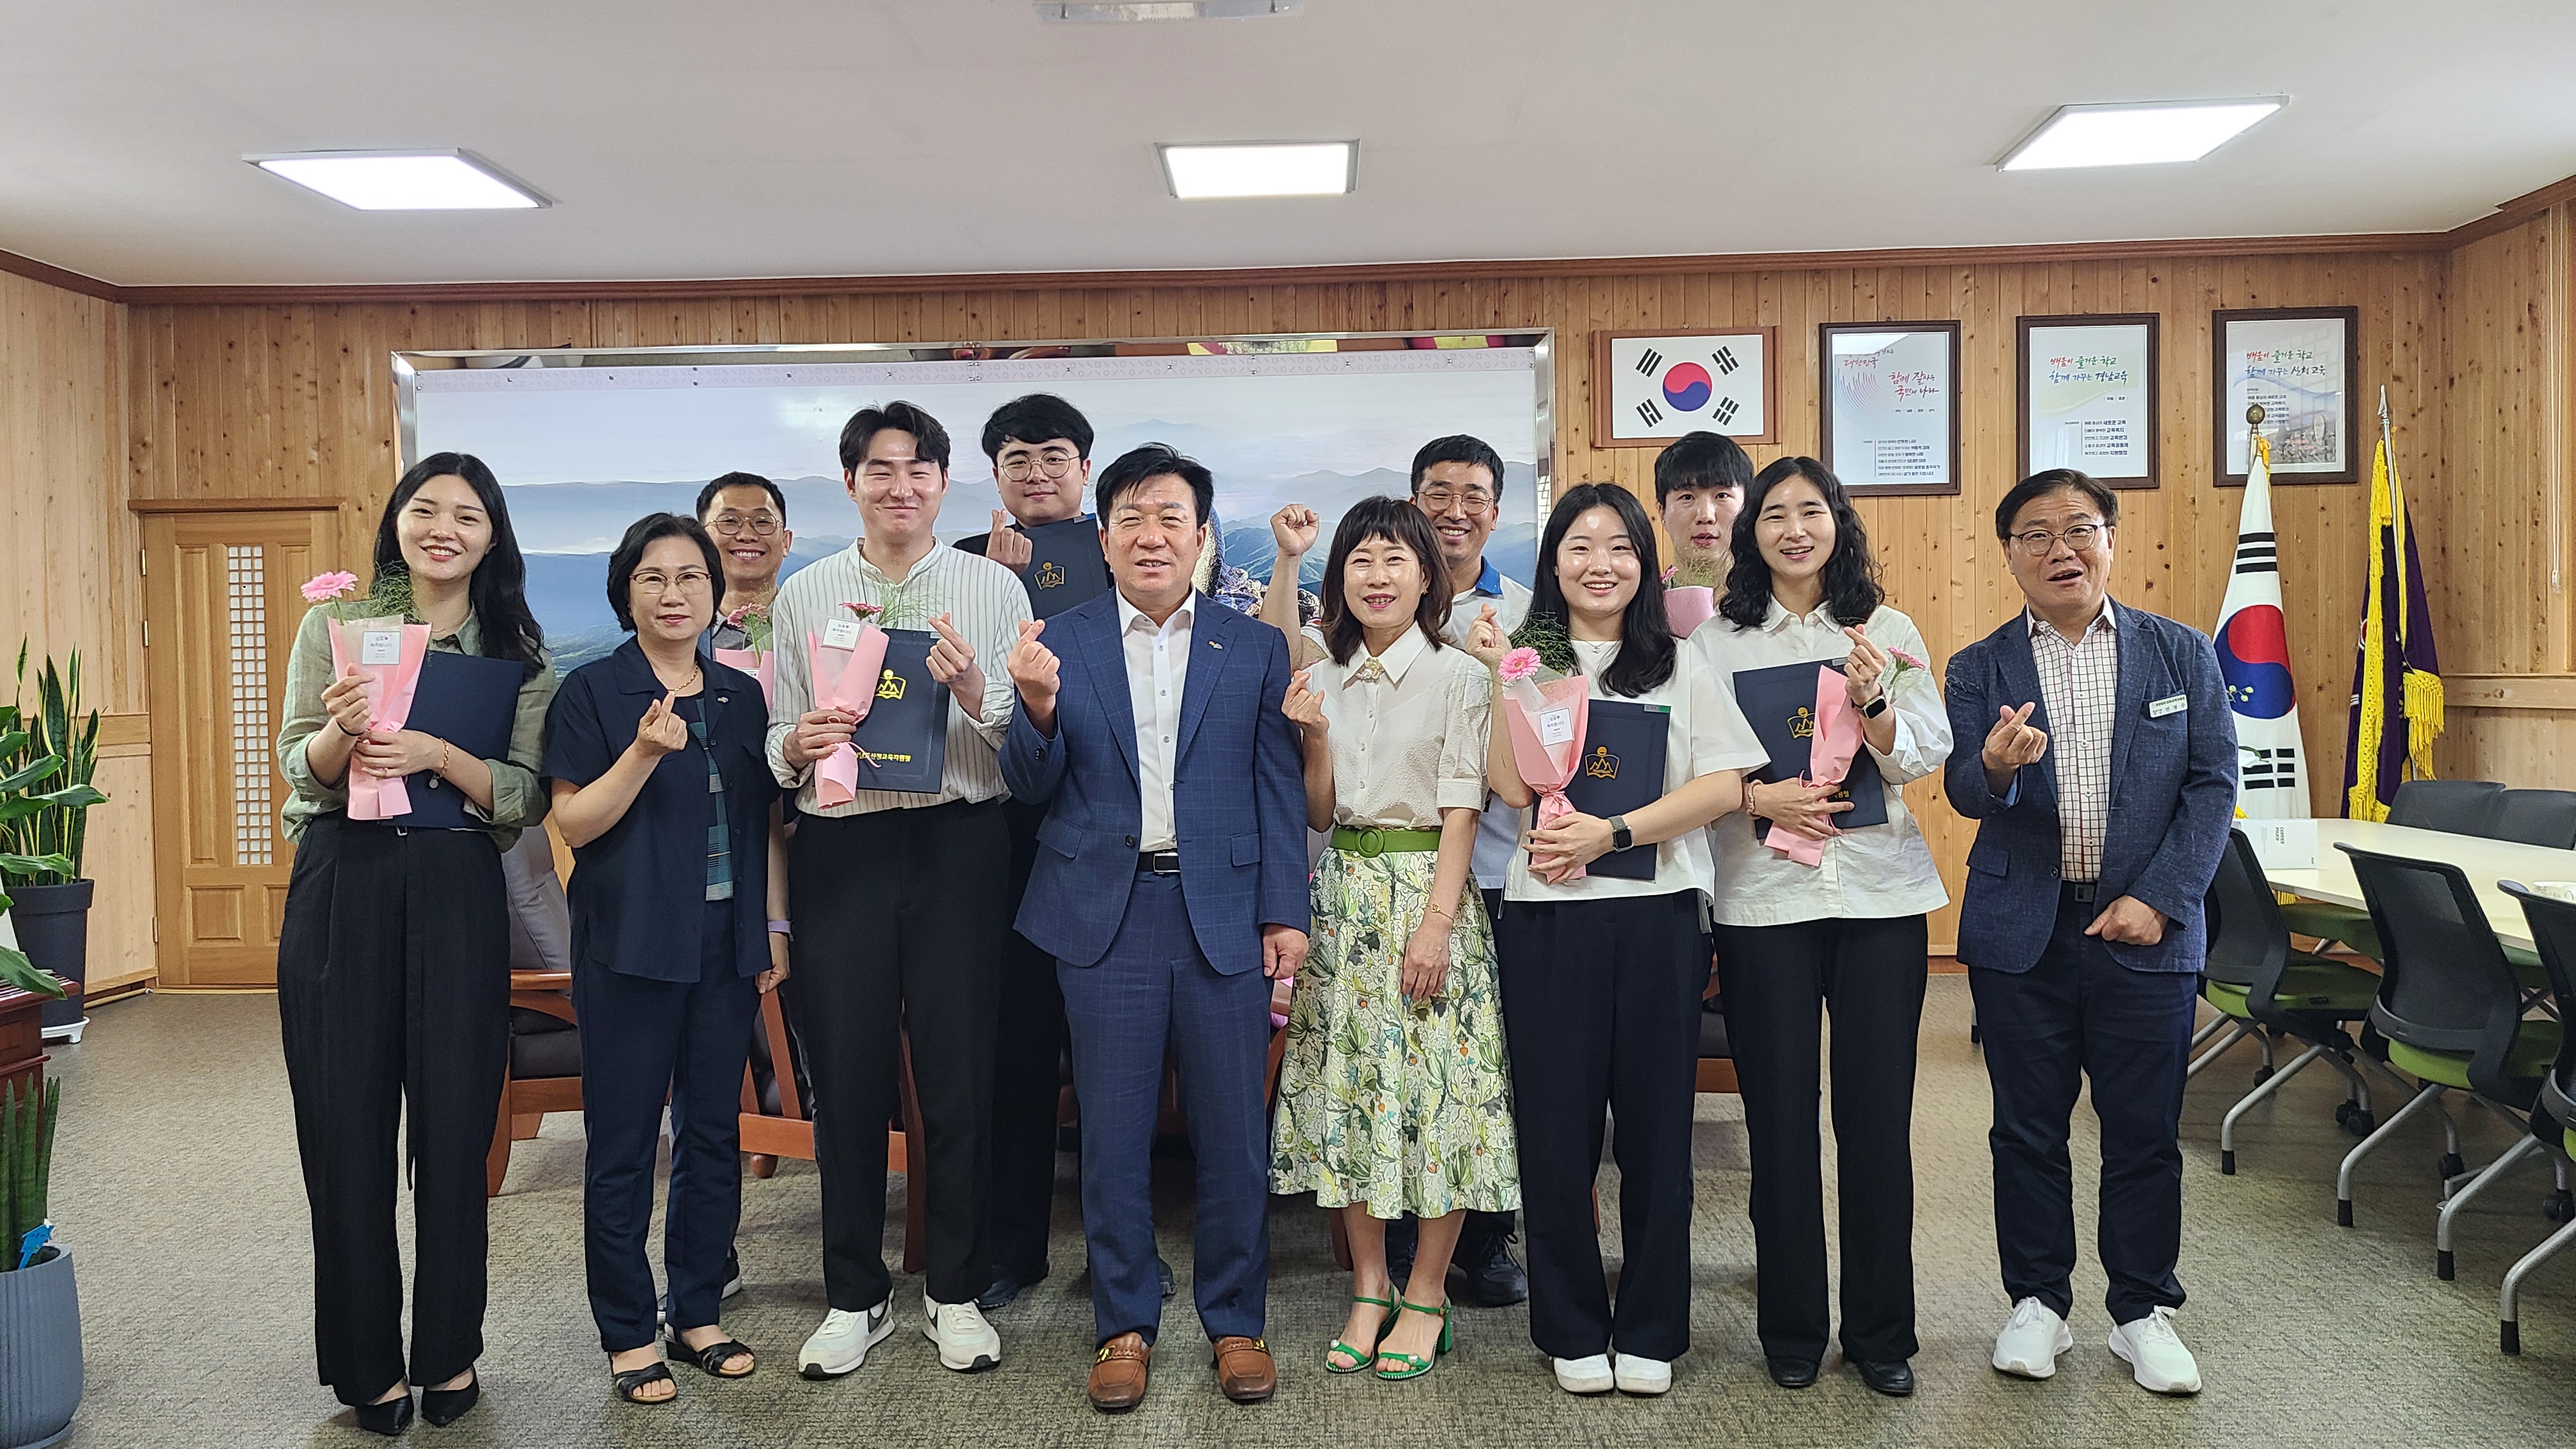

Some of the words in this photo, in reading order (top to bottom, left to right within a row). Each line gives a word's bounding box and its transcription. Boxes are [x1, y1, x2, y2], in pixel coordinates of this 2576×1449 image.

[1844, 357, 1879, 369] 대한민국
[2050, 356, 2073, 369] 배움이
[2075, 355, 2098, 369] 즐거운
[2100, 355, 2117, 367] 학교
[2246, 351, 2269, 363] 배움이
[2271, 349, 2294, 364] 즐거운
[2296, 349, 2313, 360] 학교
[1889, 371, 1910, 385] 함께
[2049, 370, 2070, 384] 함께
[2072, 373, 2092, 382] 가꾸는
[2095, 370, 2128, 386] 경남교육
[2245, 365, 2266, 378] 함께
[2268, 367, 2288, 376] 가꾸는
[1895, 385, 1917, 402] 국민의
[1919, 385, 1940, 399] 나라
